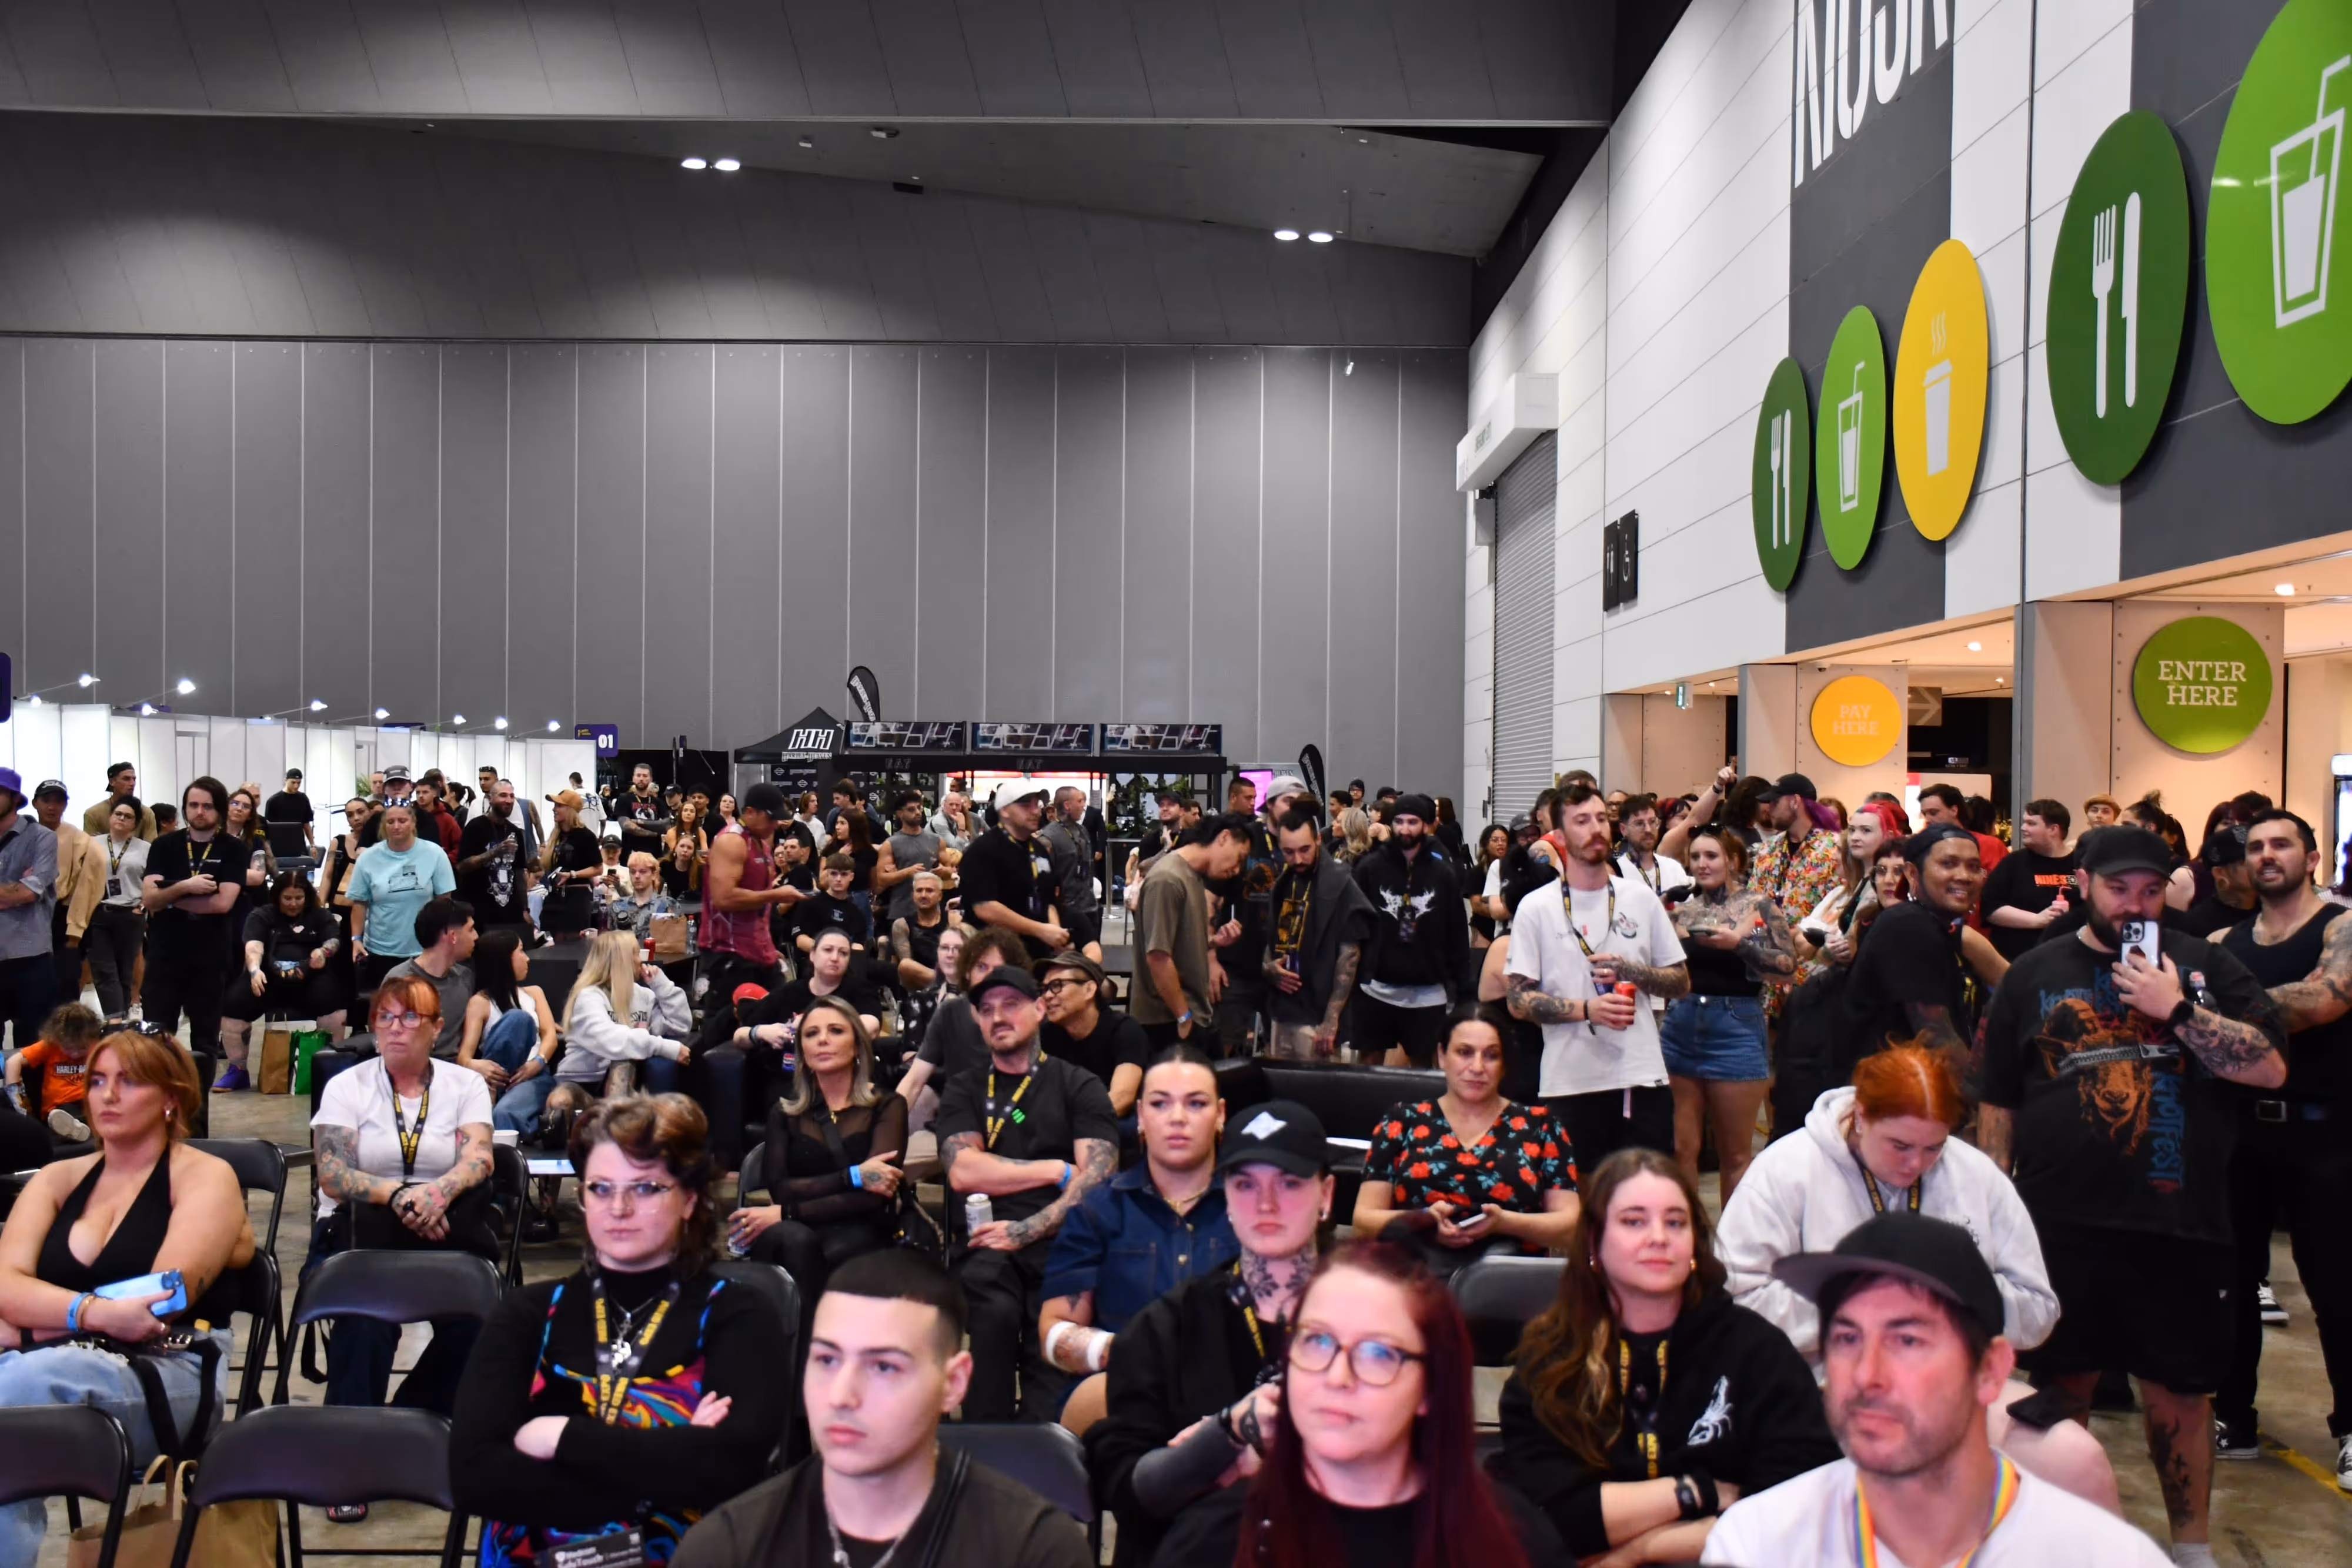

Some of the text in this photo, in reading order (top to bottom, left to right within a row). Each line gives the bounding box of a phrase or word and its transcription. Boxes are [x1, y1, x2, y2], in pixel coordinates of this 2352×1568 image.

[2158, 660, 2247, 682] ENTER
[2166, 685, 2238, 706] HERE
[1839, 704, 1873, 719] PAY
[1832, 721, 1880, 735] HERE
[598, 734, 613, 748] 01
